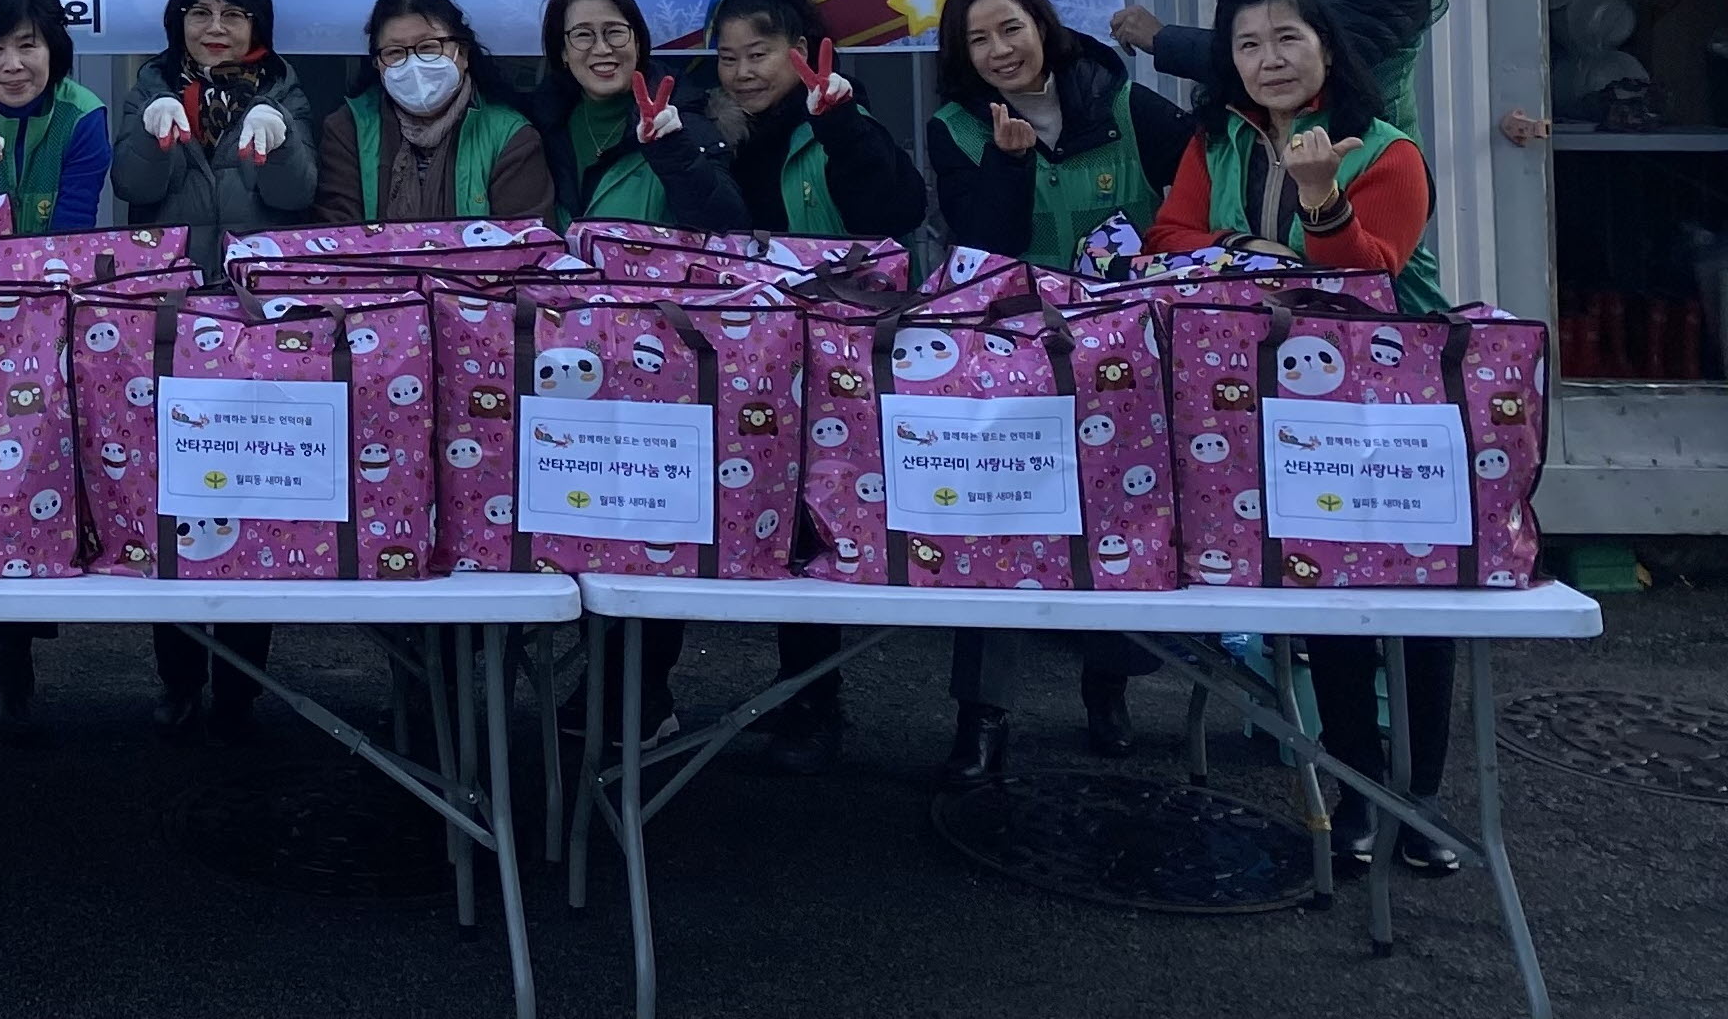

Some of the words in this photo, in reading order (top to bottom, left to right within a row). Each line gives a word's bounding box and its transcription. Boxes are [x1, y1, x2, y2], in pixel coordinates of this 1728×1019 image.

[175, 437, 238, 454] 산타꾸러미
[244, 441, 296, 457] 사랑나눔
[300, 442, 326, 457] 행사
[538, 457, 602, 475] 산타꾸러미
[608, 461, 659, 478] 사랑나눔
[664, 464, 691, 479] 행사
[902, 455, 969, 471] 산타꾸러미
[975, 457, 1025, 472] 사랑나눔
[1029, 455, 1055, 471] 행사
[1284, 459, 1354, 477] 산타꾸러미
[1360, 463, 1413, 479] 사랑나눔
[1417, 465, 1445, 479] 행사
[265, 475, 302, 486] 새마을회
[629, 497, 666, 508] 새마을회
[995, 491, 1032, 501] 새마을회
[1383, 498, 1421, 510] 새마을회
